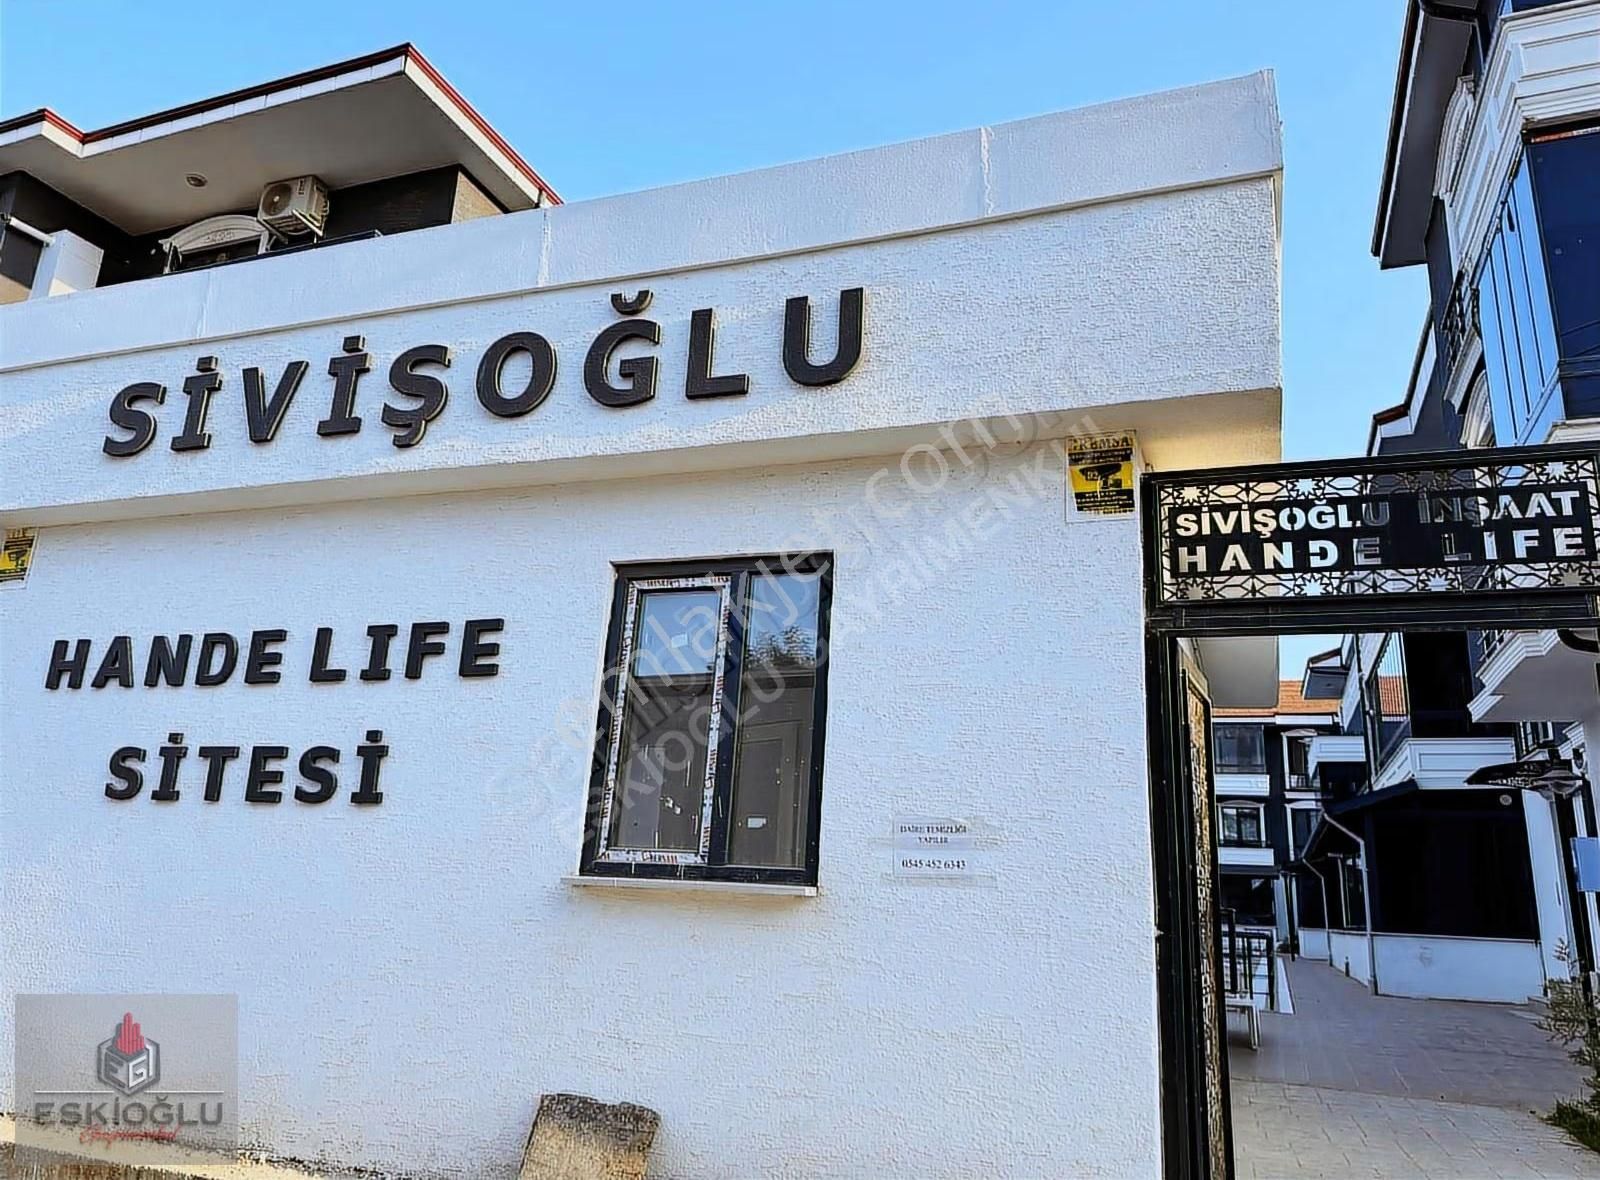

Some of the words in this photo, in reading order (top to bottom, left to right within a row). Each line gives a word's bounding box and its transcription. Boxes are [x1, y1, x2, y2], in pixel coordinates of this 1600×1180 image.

[103, 287, 865, 458] SİVİŞOĞLU
[1175, 497, 1390, 539] SİVİŞOĞLU
[1418, 489, 1581, 527] İNŞAAT
[1177, 536, 1382, 574] HANDE
[1441, 527, 1587, 561] LIFE
[45, 628, 290, 690] HANDE
[309, 618, 505, 684] LIFE
[104, 729, 389, 804] SİTESİ
